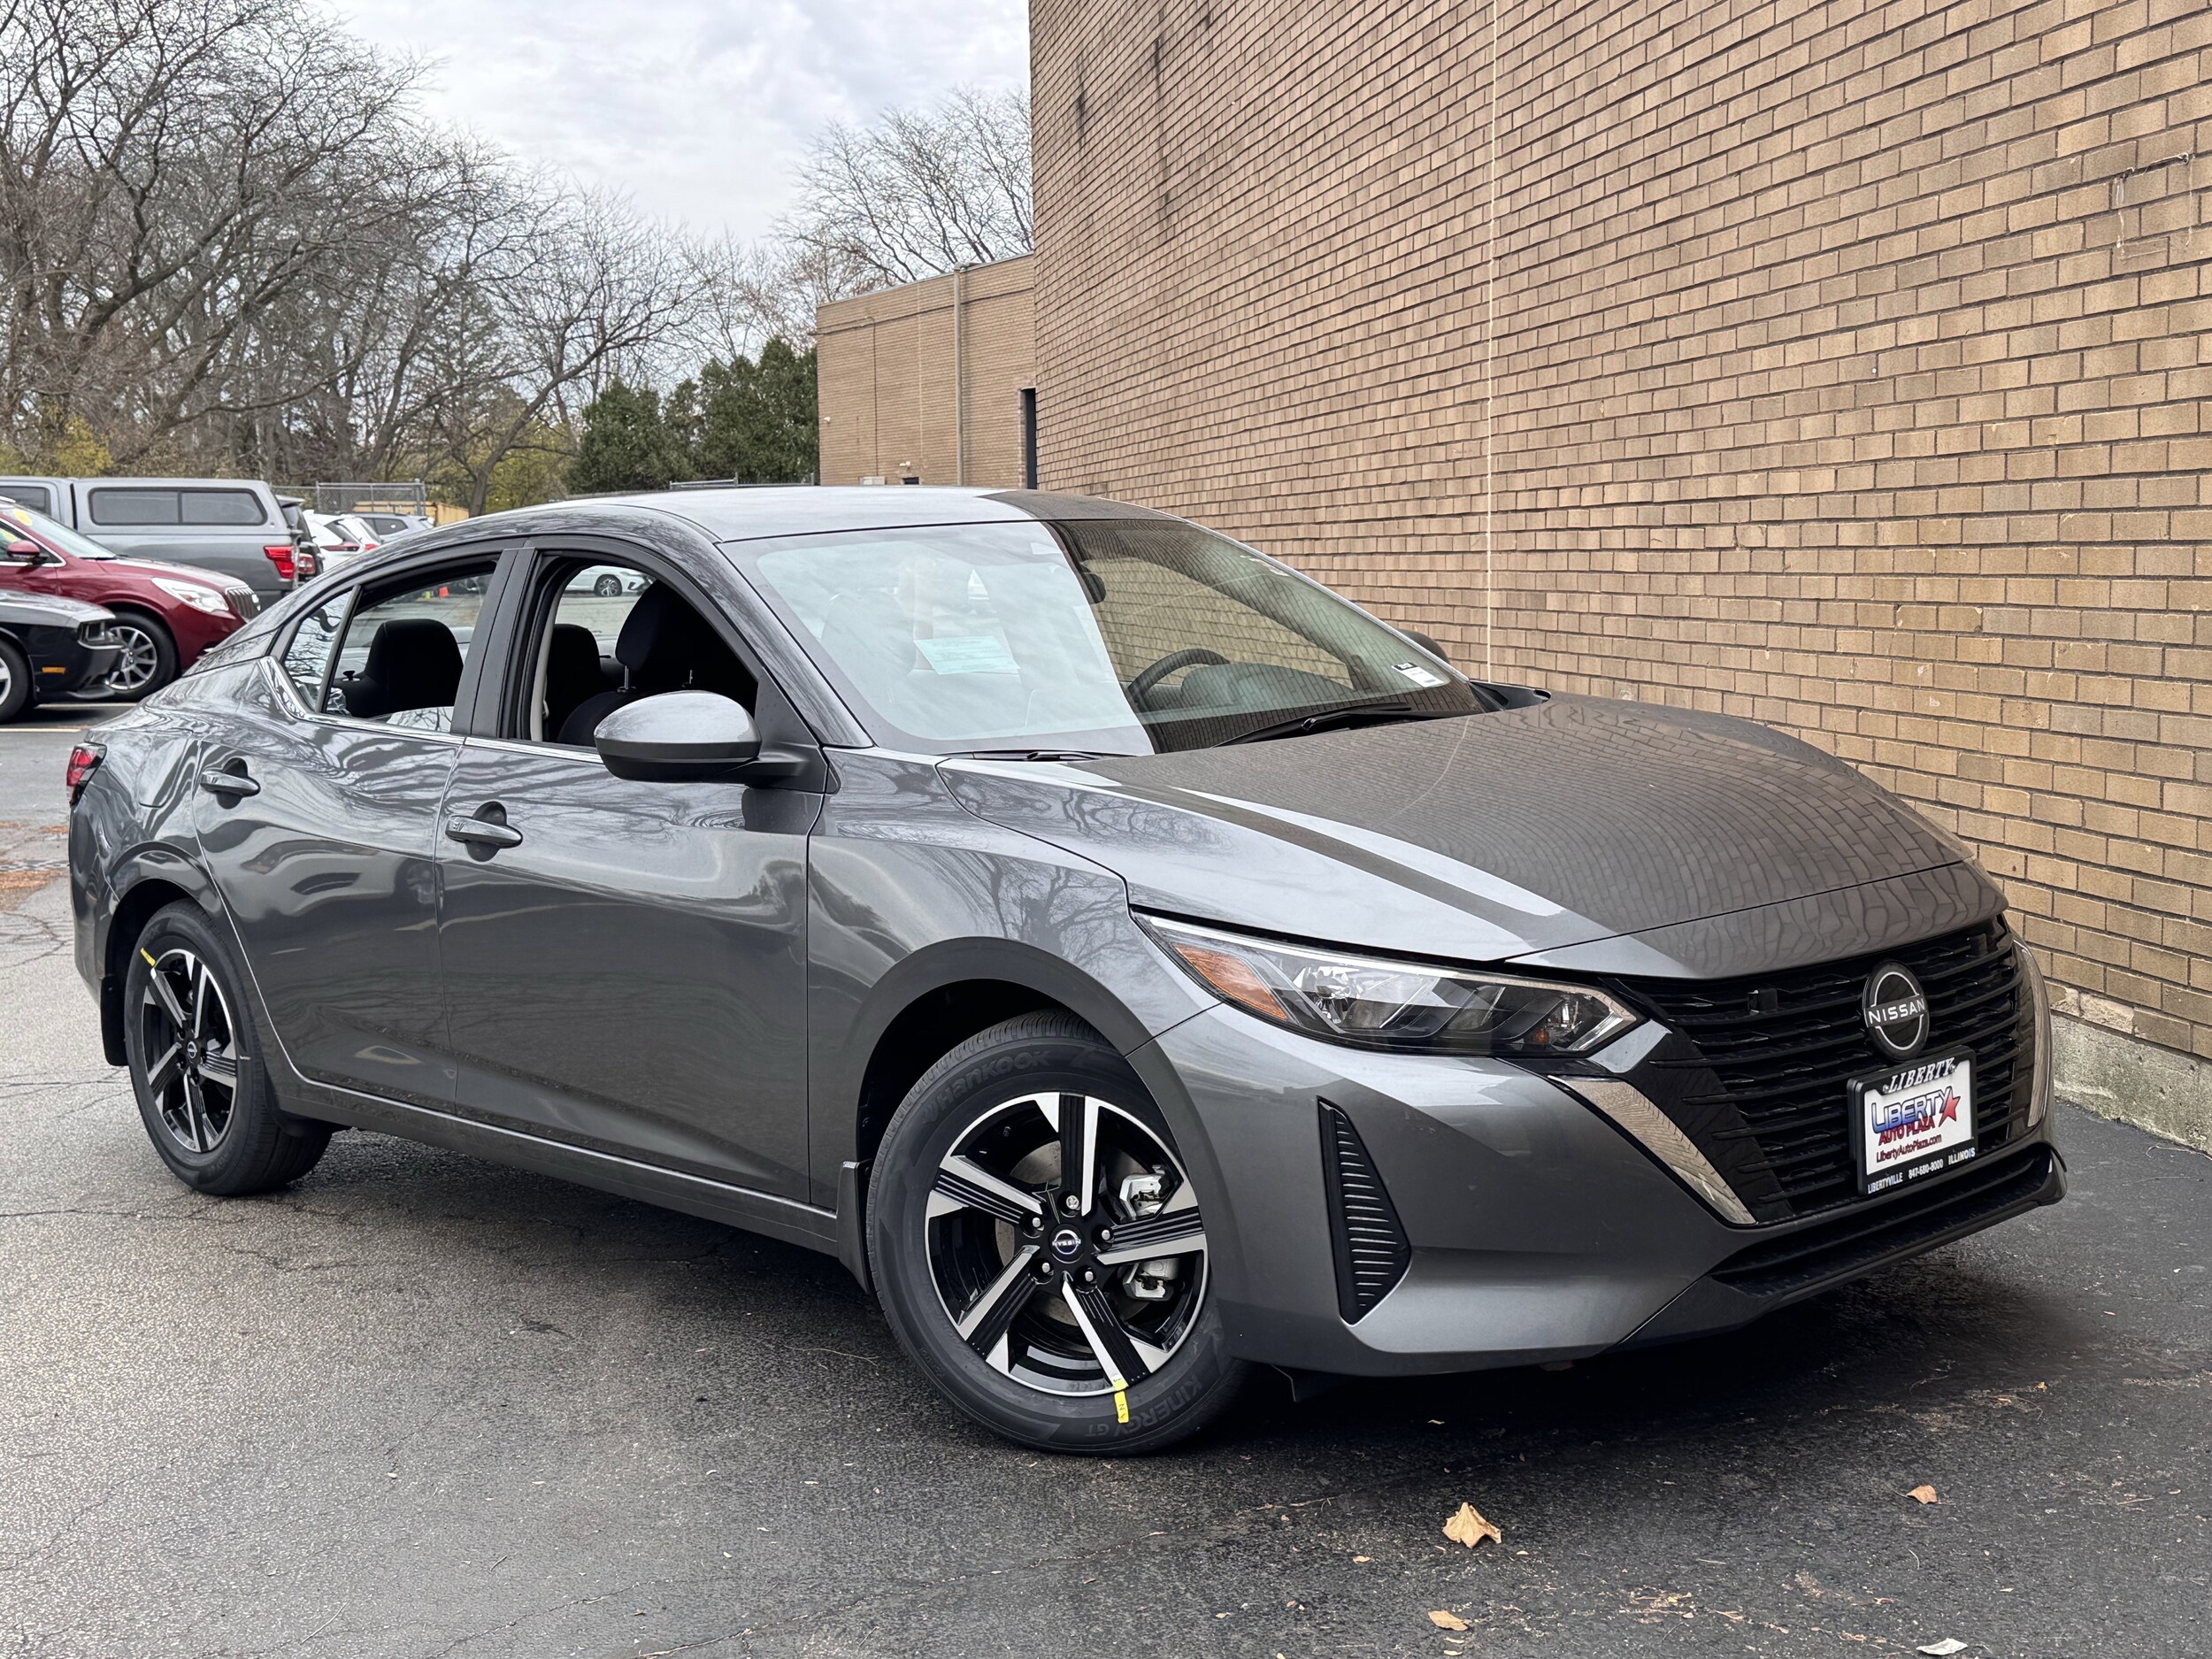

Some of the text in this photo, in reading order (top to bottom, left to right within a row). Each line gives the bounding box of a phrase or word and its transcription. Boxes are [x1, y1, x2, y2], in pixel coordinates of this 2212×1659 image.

[1868, 997, 1925, 1025] NISSAN
[1888, 1056, 1955, 1094] LIBERTY
[1871, 1085, 1953, 1134] LIBERTY
[1876, 1133, 1942, 1164] LibertyAutoPlaza.com
[1878, 1115, 1936, 1147] AUTO PLAZA
[1868, 1171, 1903, 1194] LIBERTYVILLE
[1947, 1147, 1976, 1165] ILLINOIS
